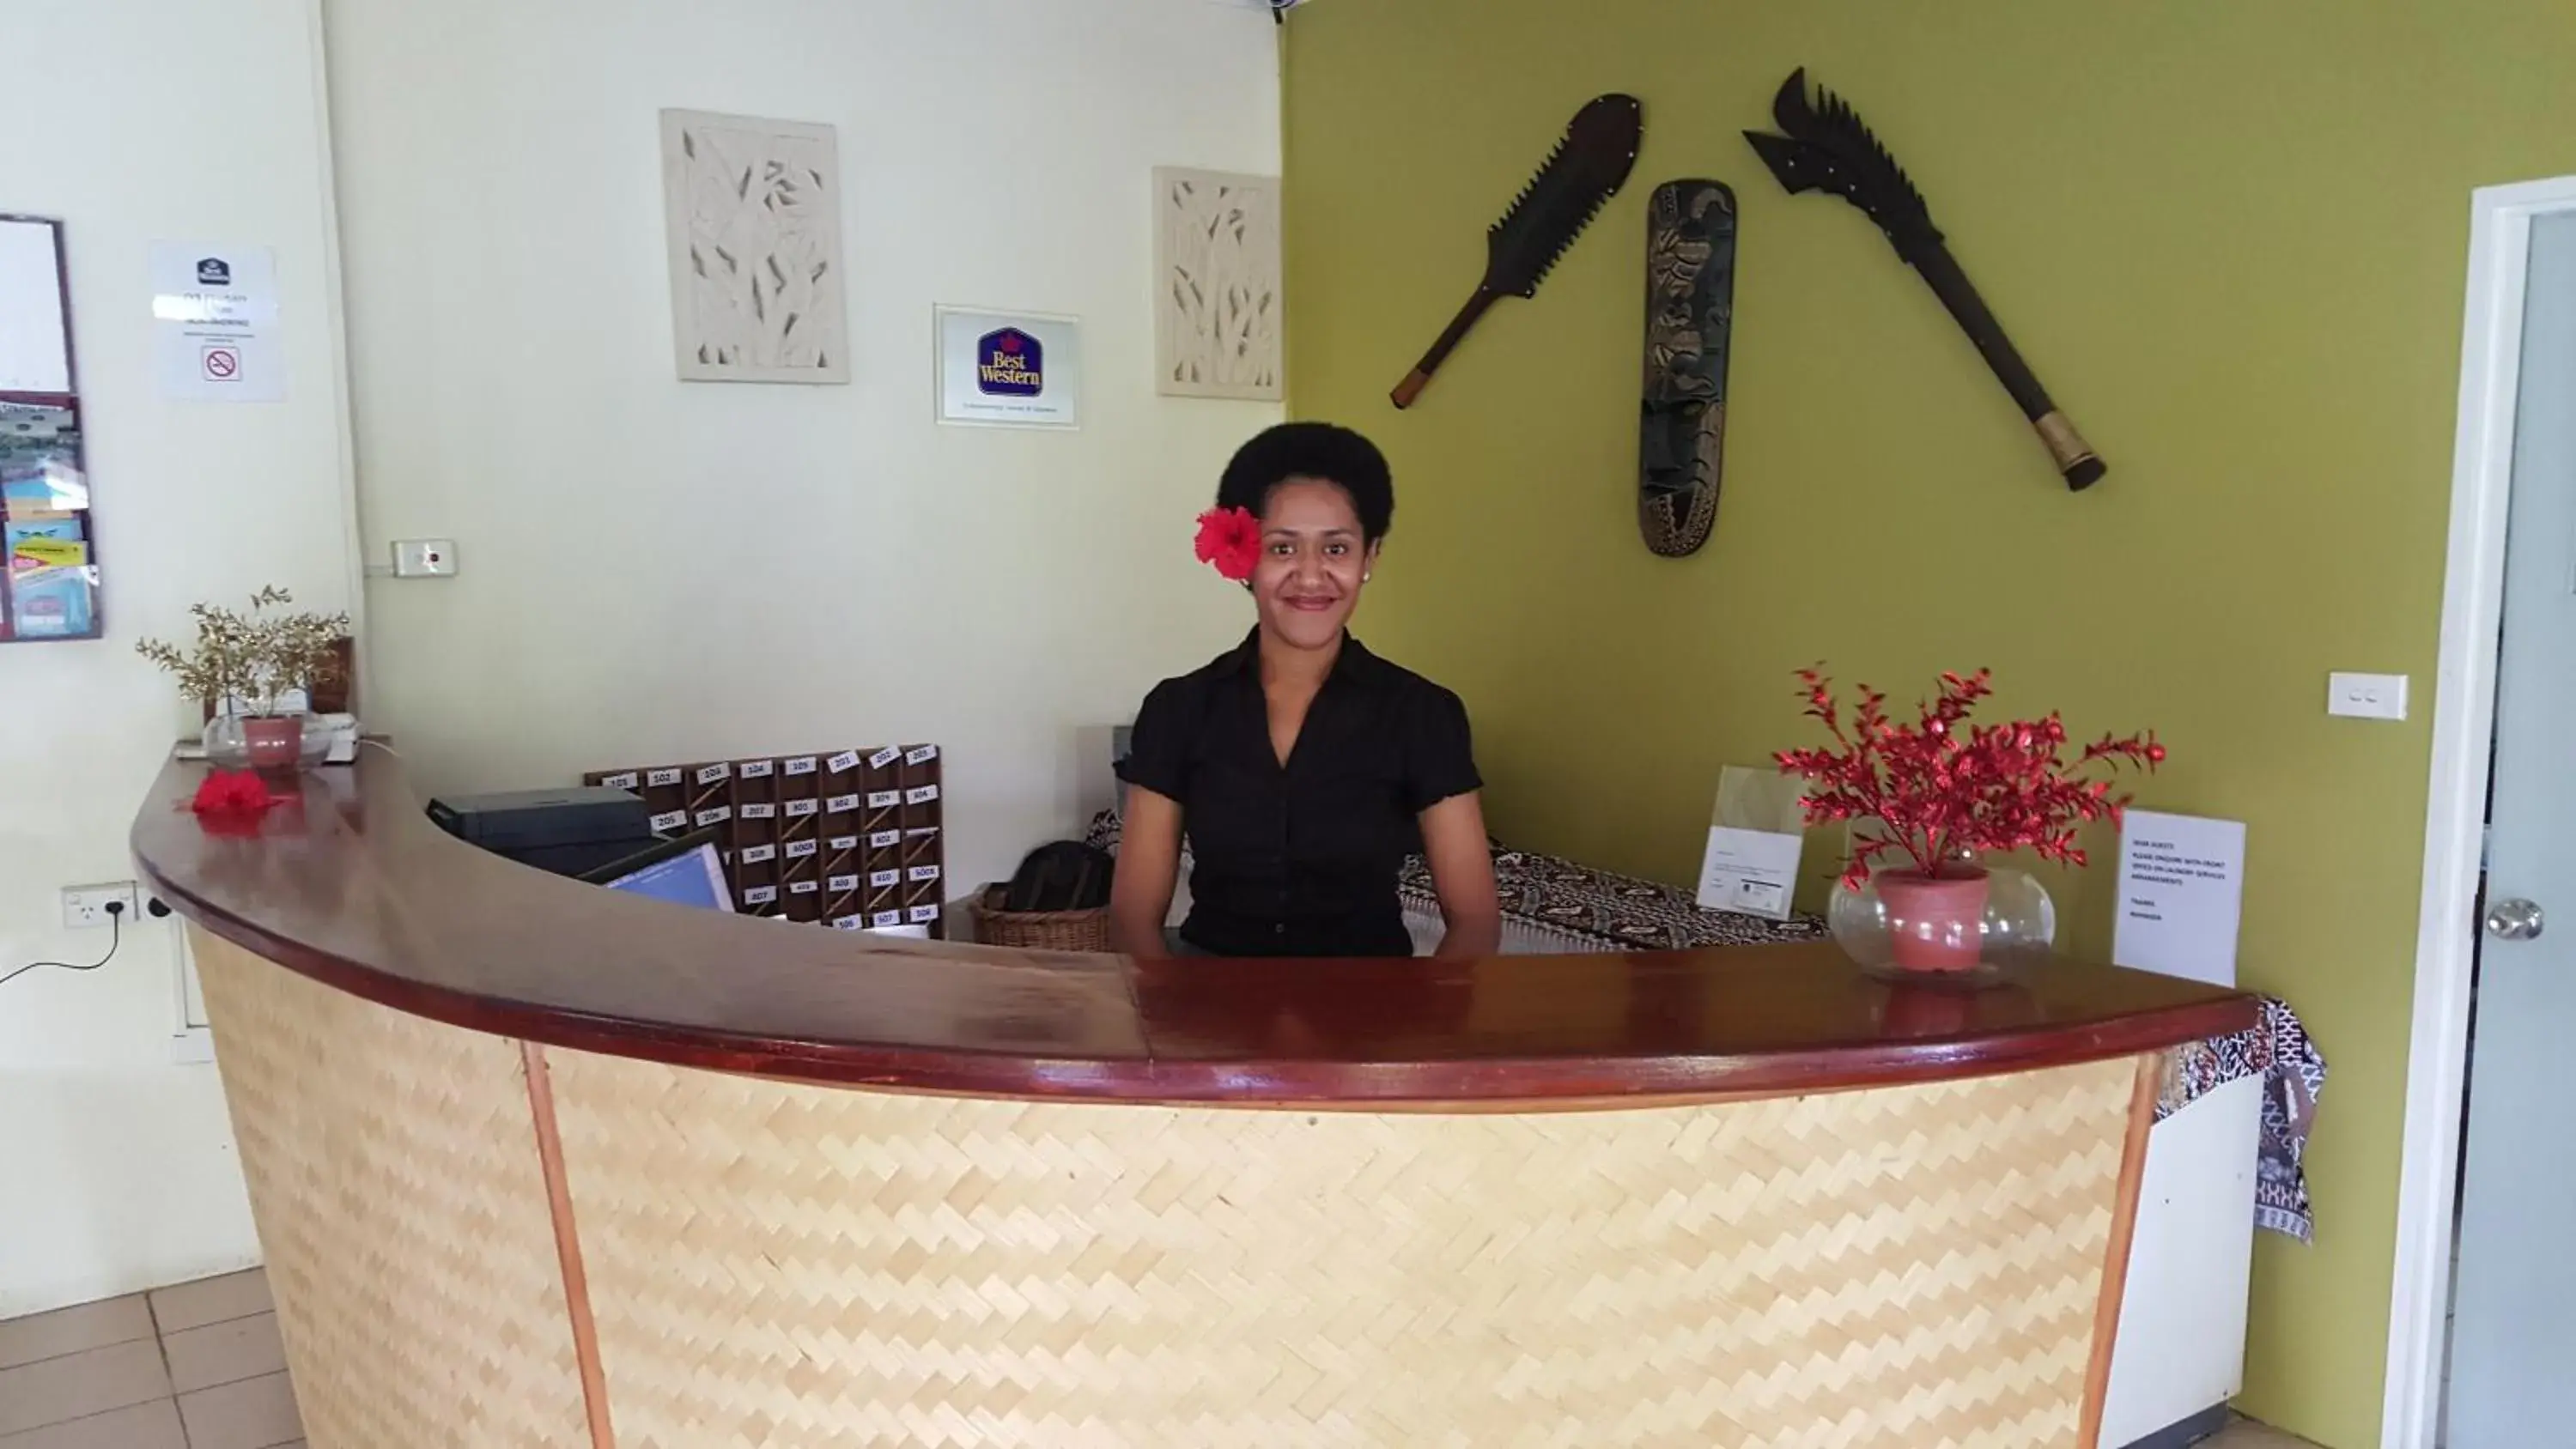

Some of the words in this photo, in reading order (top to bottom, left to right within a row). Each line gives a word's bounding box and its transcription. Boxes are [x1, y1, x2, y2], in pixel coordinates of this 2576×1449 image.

[993, 351, 1026, 370] Best
[980, 365, 1040, 385] Western
[653, 773, 671, 783] 102
[658, 816, 675, 827] 205
